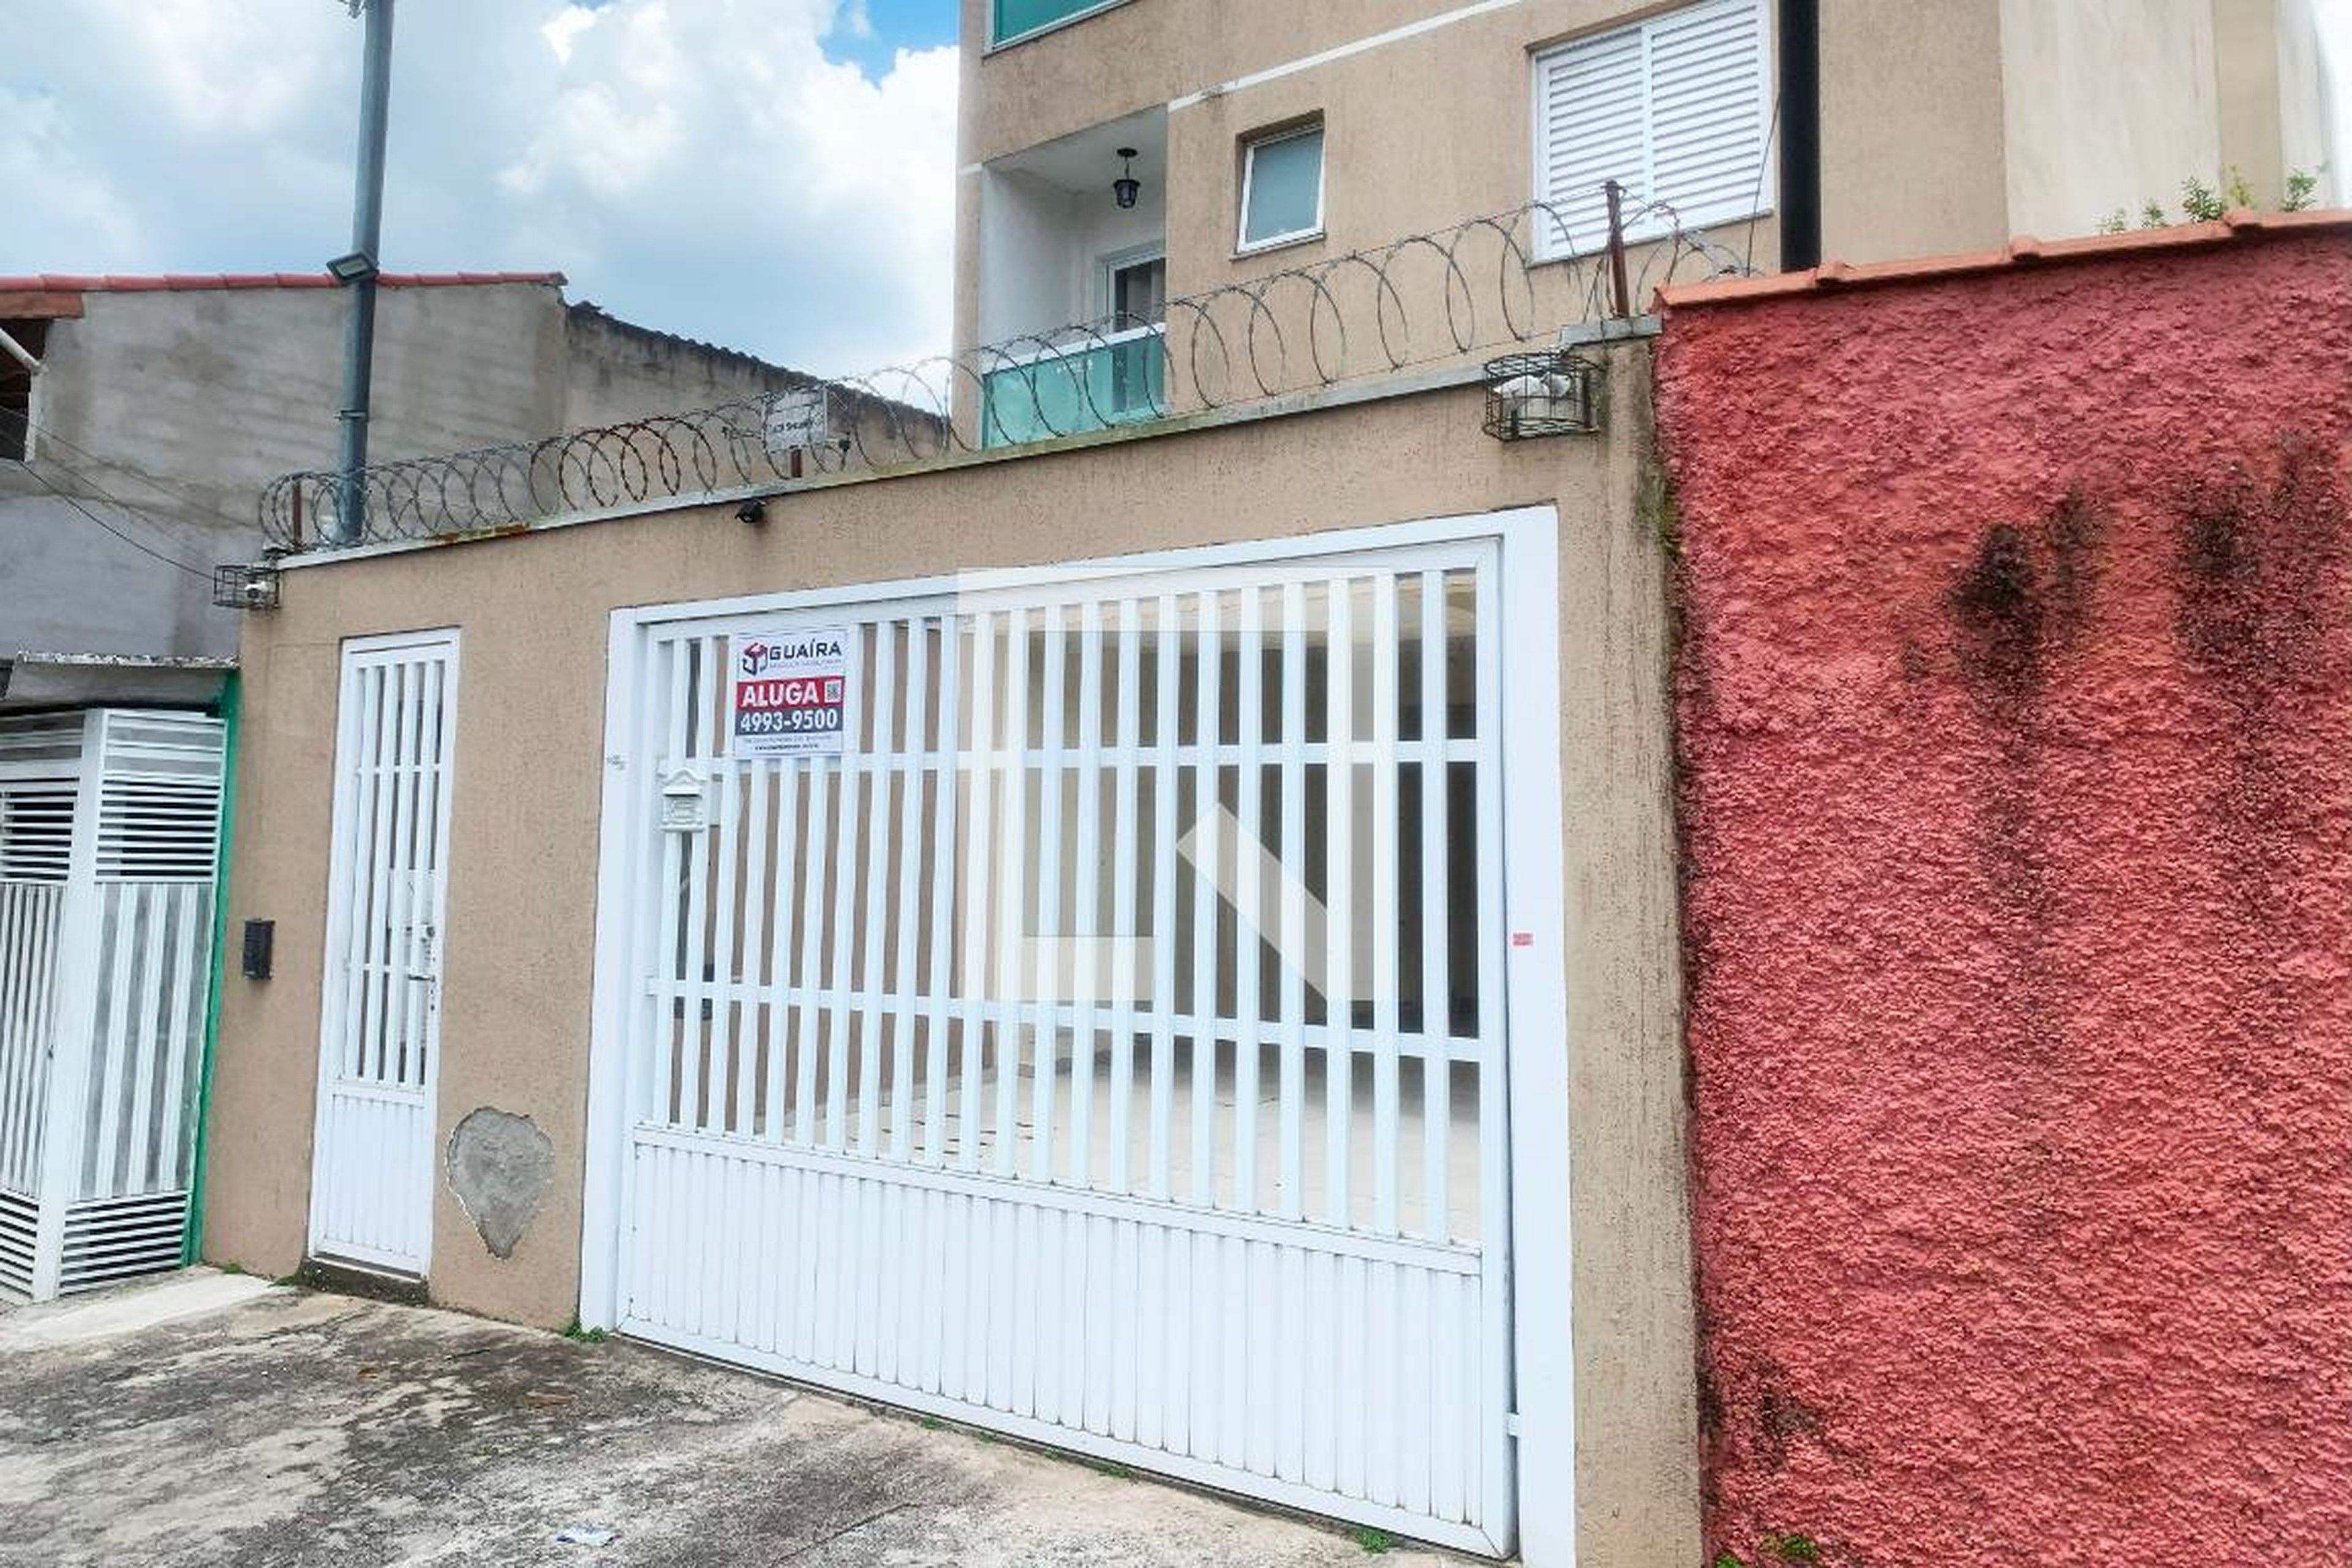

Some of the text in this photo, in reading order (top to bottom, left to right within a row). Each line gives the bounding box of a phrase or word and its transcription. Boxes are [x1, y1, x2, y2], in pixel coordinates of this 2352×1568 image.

[769, 638, 842, 660] GUAÍRA
[741, 681, 819, 707] ALUGA
[741, 708, 838, 732] 4993-9500
